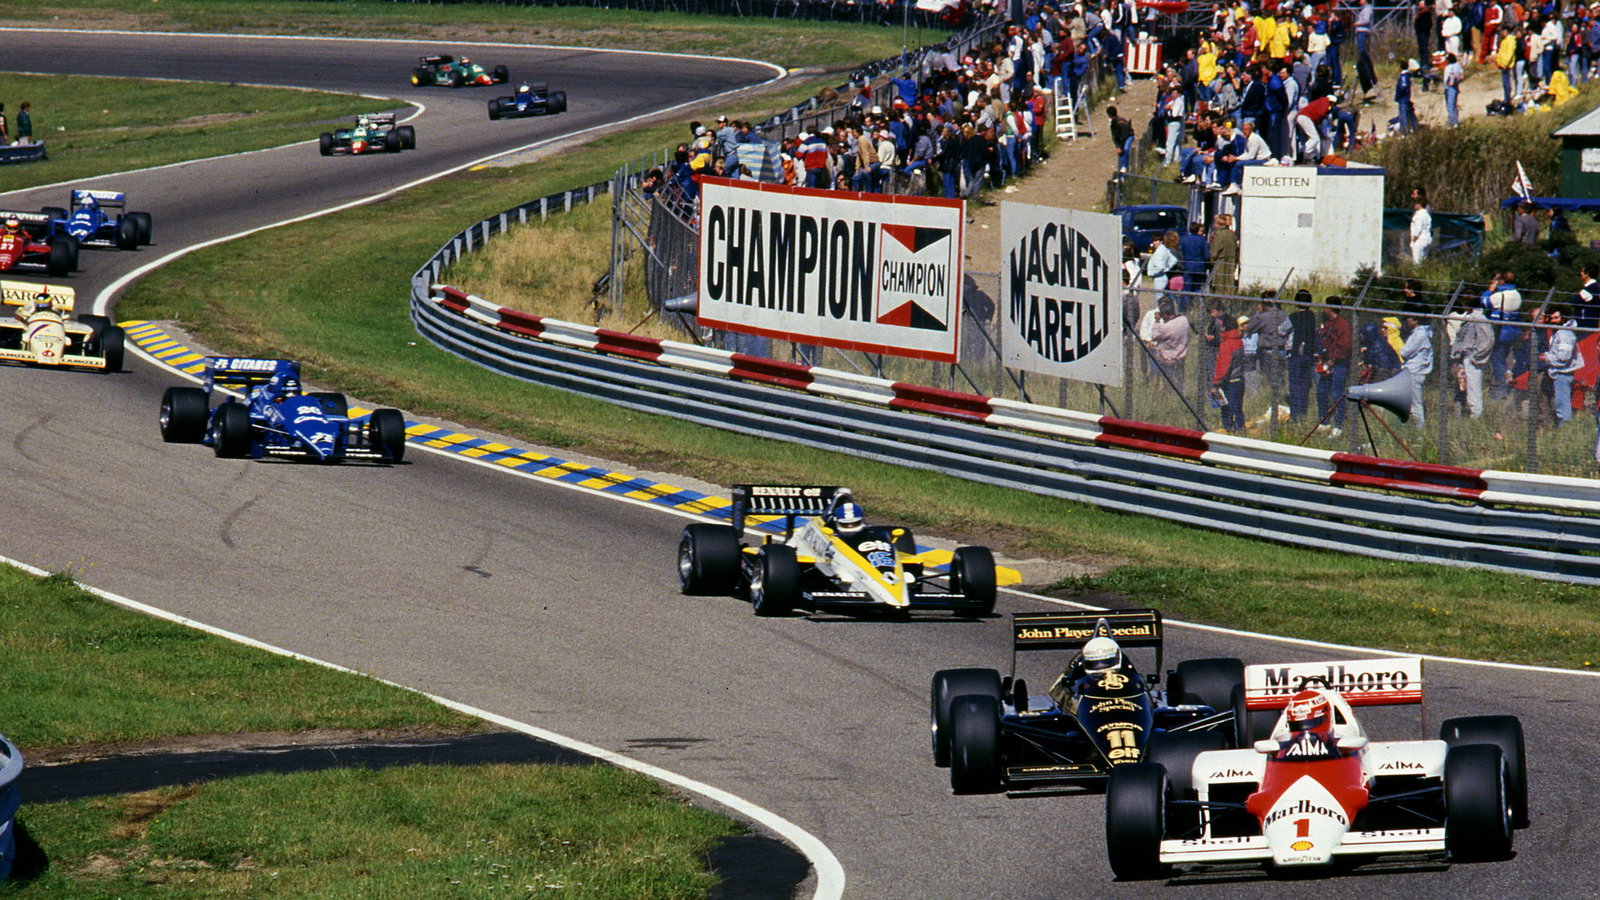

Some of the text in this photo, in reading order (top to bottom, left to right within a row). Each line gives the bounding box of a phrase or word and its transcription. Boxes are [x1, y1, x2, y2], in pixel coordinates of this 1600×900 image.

[1250, 176, 1310, 187] TOILETTEN
[707, 204, 876, 323] CHAMPION
[1010, 222, 1109, 293] MAGNETI
[881, 259, 946, 298] CHAMPION
[1, 288, 69, 305] BARAY
[1010, 292, 1109, 363] MARELLI
[230, 358, 278, 371] GITANES
[752, 487, 821, 496] RENAULT elf
[858, 540, 891, 552] elf
[1018, 628, 1052, 639] John
[1106, 730, 1136, 748] 11
[1108, 747, 1140, 759] elf
[1265, 799, 1347, 828] Marlboro
[1293, 818, 1310, 838] 1
[1361, 829, 1431, 838] Shell
[1182, 837, 1251, 846] Shell
